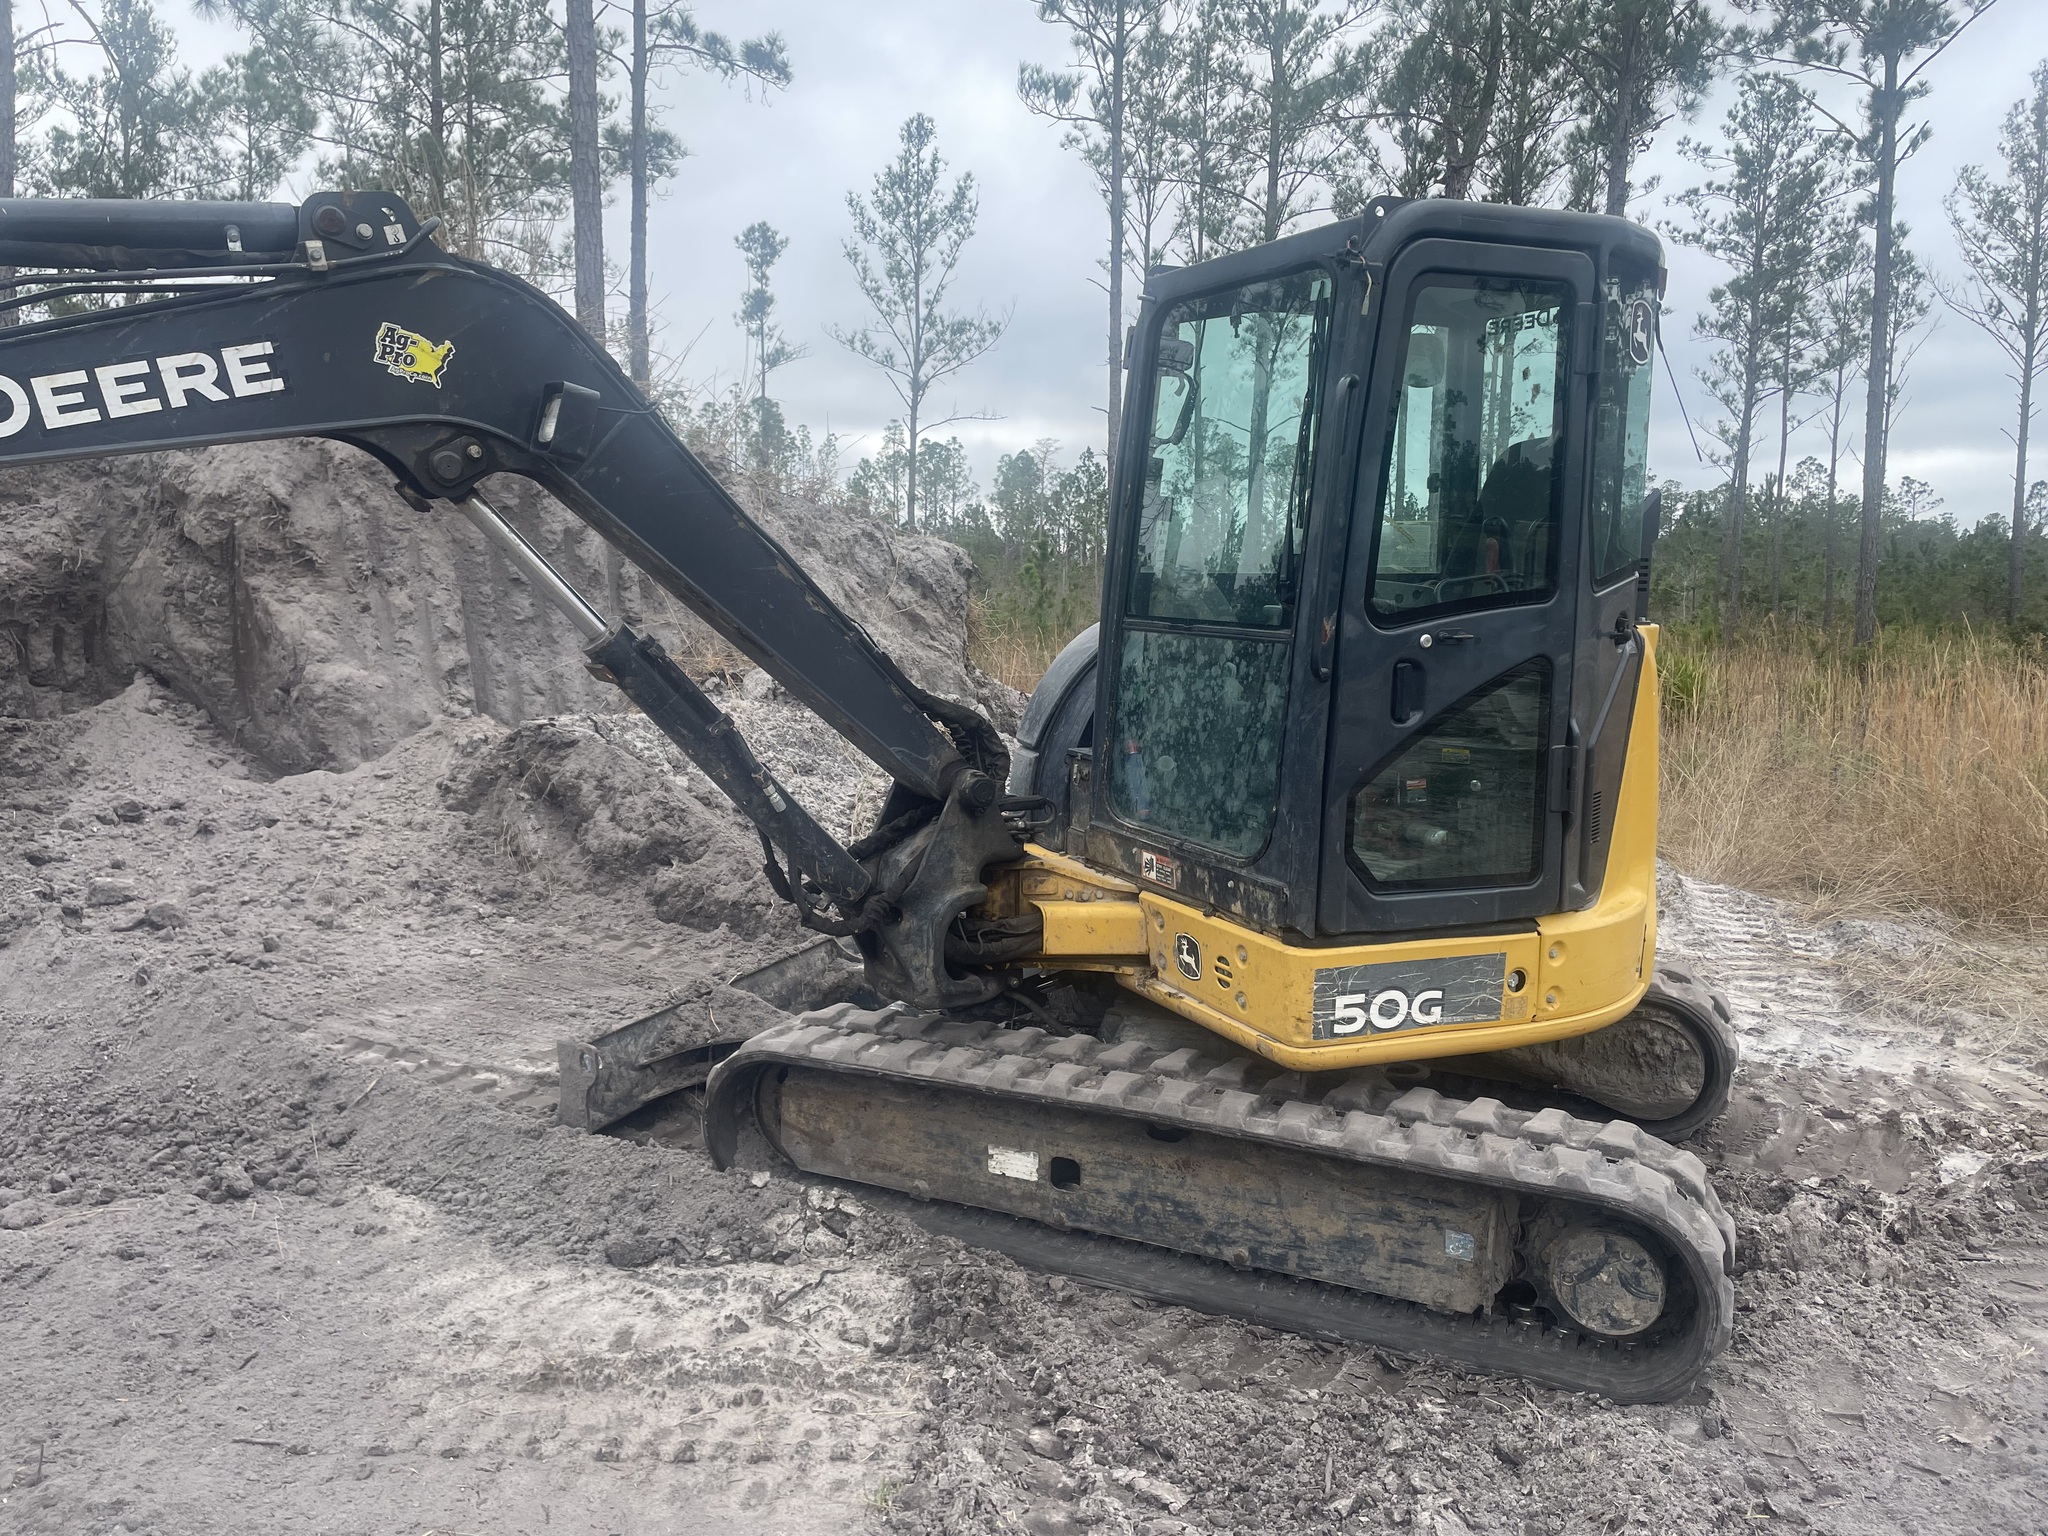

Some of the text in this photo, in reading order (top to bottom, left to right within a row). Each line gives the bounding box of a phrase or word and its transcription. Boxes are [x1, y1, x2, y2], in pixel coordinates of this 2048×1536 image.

[380, 326, 418, 351] Ag-
[378, 343, 416, 366] Pro
[1333, 989, 1444, 1034] 50G
